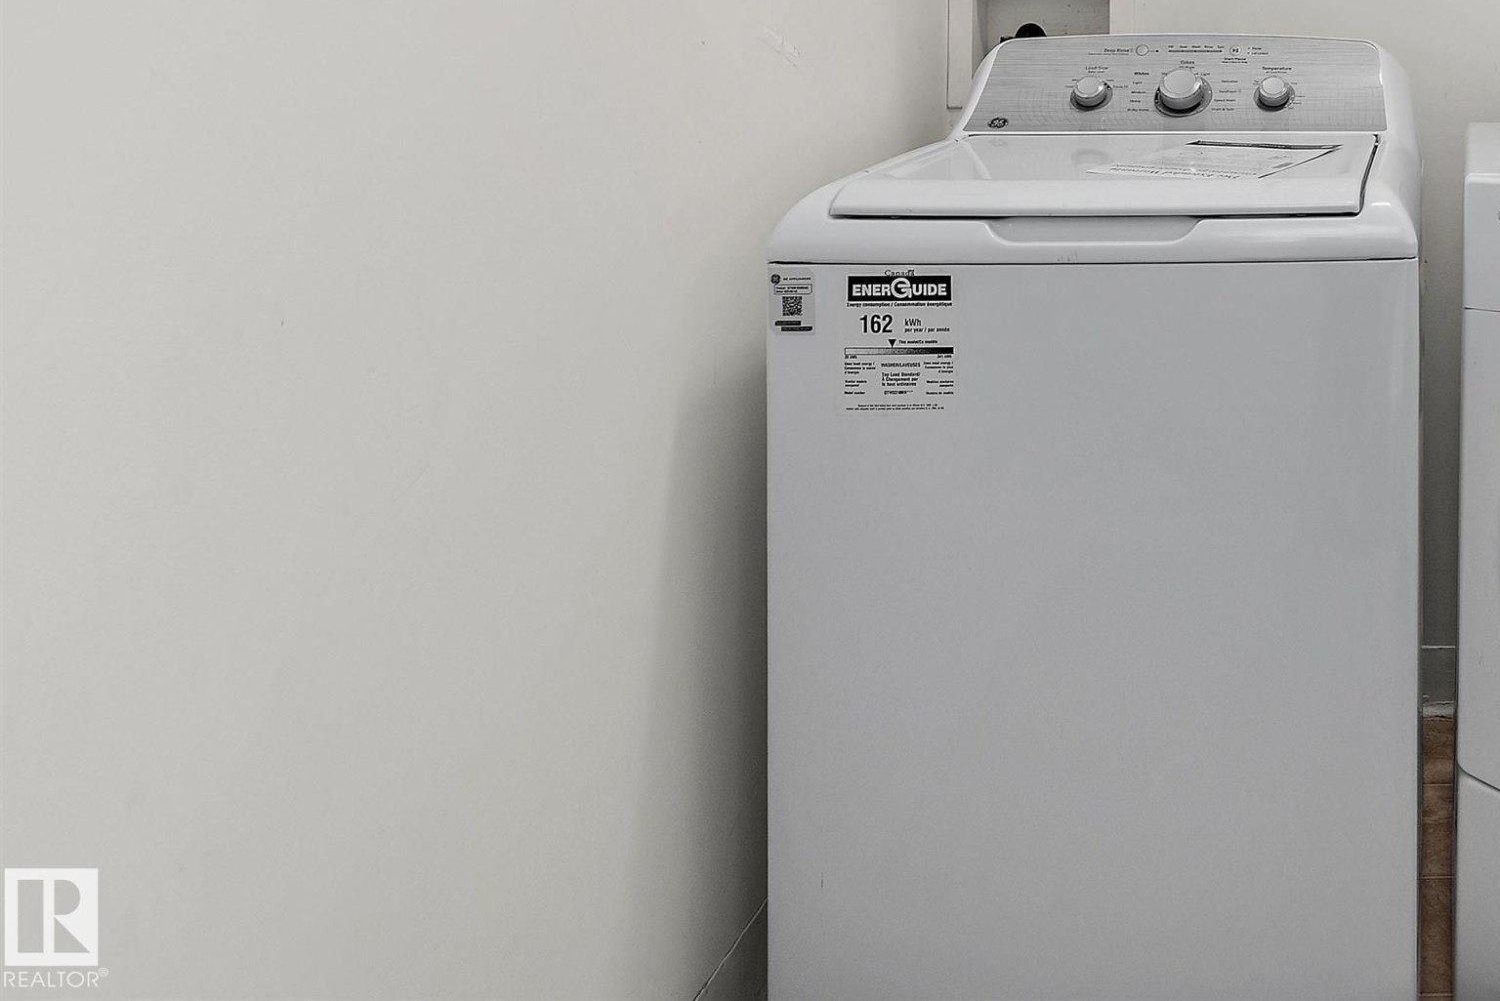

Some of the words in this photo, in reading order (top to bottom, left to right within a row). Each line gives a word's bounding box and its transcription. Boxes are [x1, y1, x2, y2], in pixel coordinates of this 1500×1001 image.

[852, 277, 947, 298] ENERGUIDE
[859, 314, 893, 334] 162
[904, 318, 921, 327] kWh
